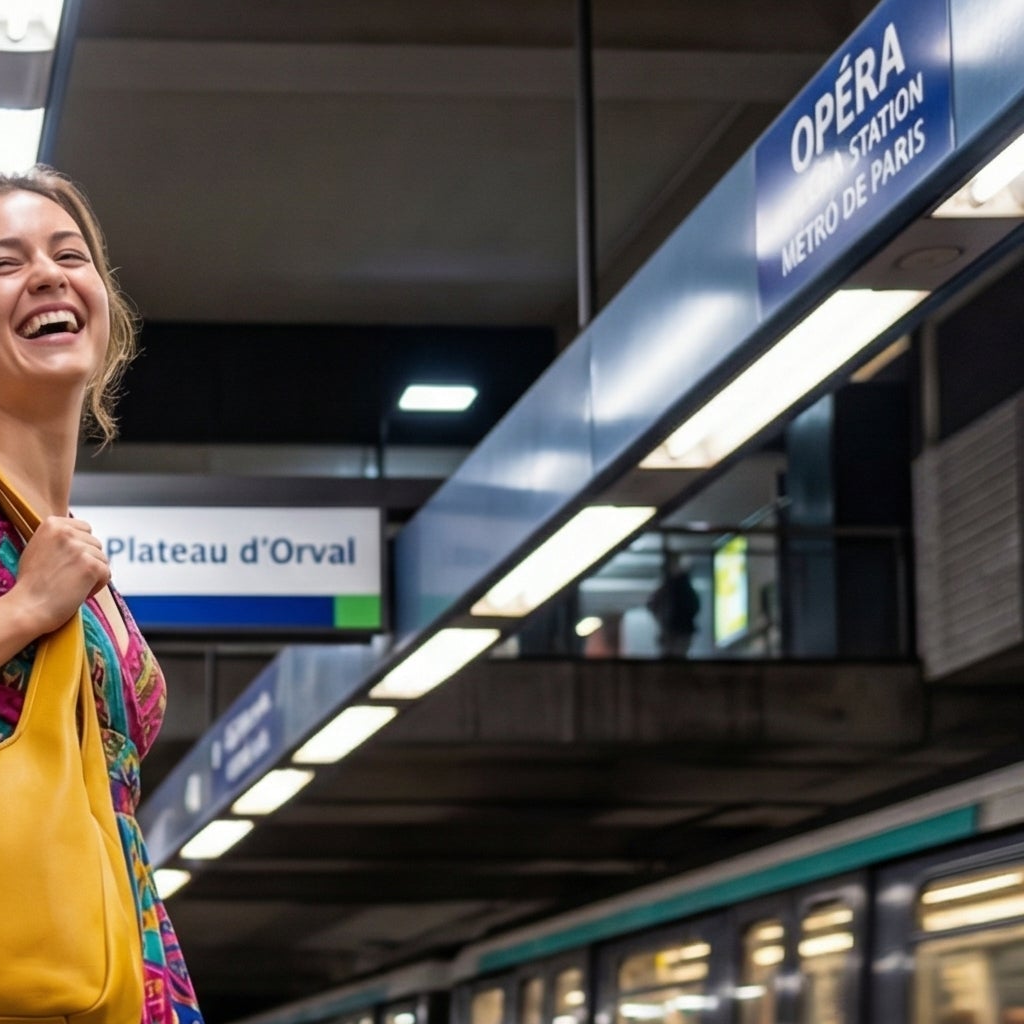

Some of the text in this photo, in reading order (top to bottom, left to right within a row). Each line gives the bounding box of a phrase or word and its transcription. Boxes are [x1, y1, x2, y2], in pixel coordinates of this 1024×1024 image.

[790, 22, 906, 173] OPÉRA
[849, 71, 924, 169] STATION
[842, 173, 868, 220] DE
[870, 118, 925, 194] PARIS
[106, 536, 357, 565] Plateau d'Orval
